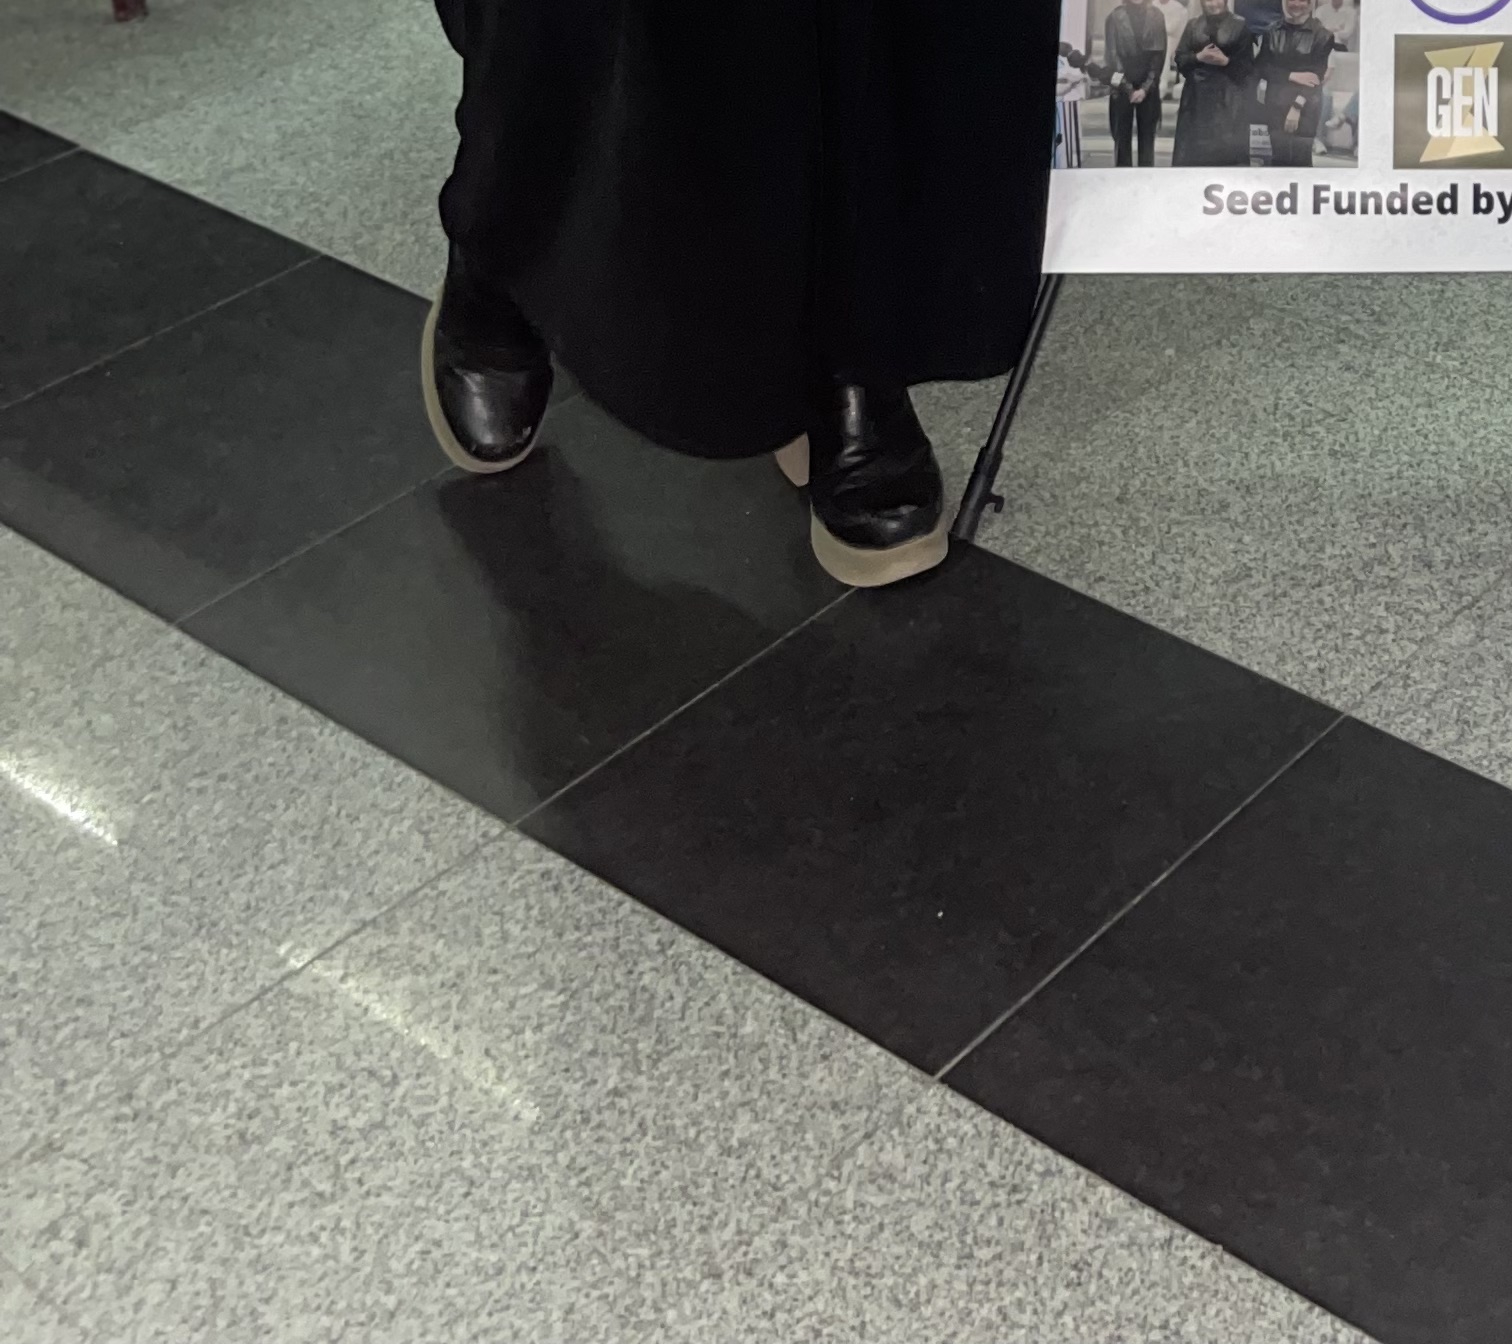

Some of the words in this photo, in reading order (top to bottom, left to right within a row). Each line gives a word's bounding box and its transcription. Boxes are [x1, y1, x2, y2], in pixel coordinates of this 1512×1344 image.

[1426, 66, 1499, 138] GEN
[1202, 183, 1300, 216] Seed
[1312, 183, 1460, 217] Funded
